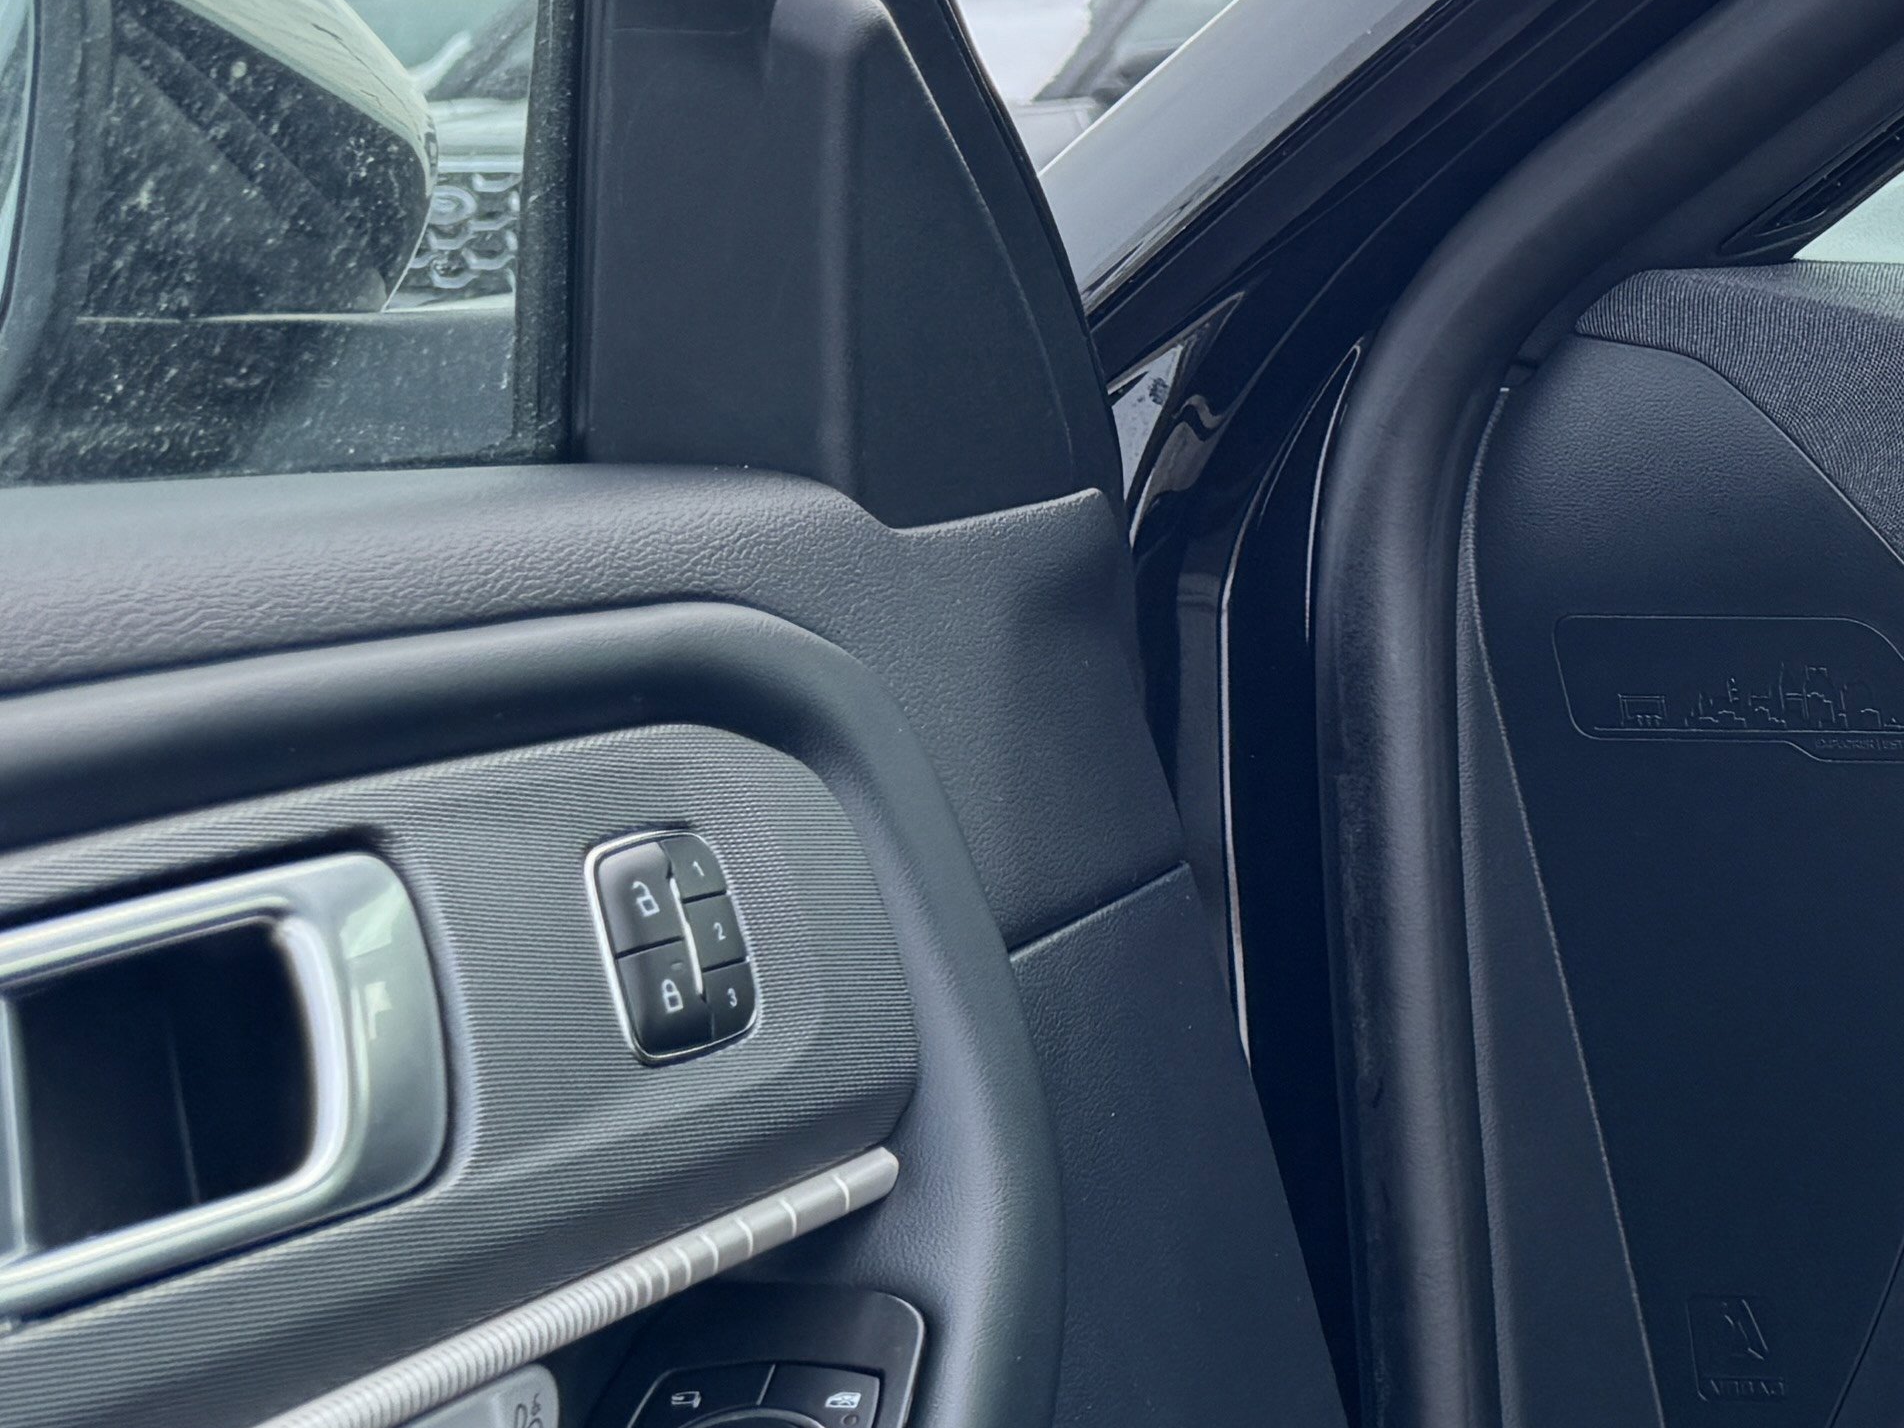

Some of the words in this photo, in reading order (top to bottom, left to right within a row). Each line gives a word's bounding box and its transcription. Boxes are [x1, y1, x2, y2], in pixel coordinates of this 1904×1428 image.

[693, 861, 704, 877] 1
[713, 922, 726, 941] 2
[727, 987, 738, 1008] 3
